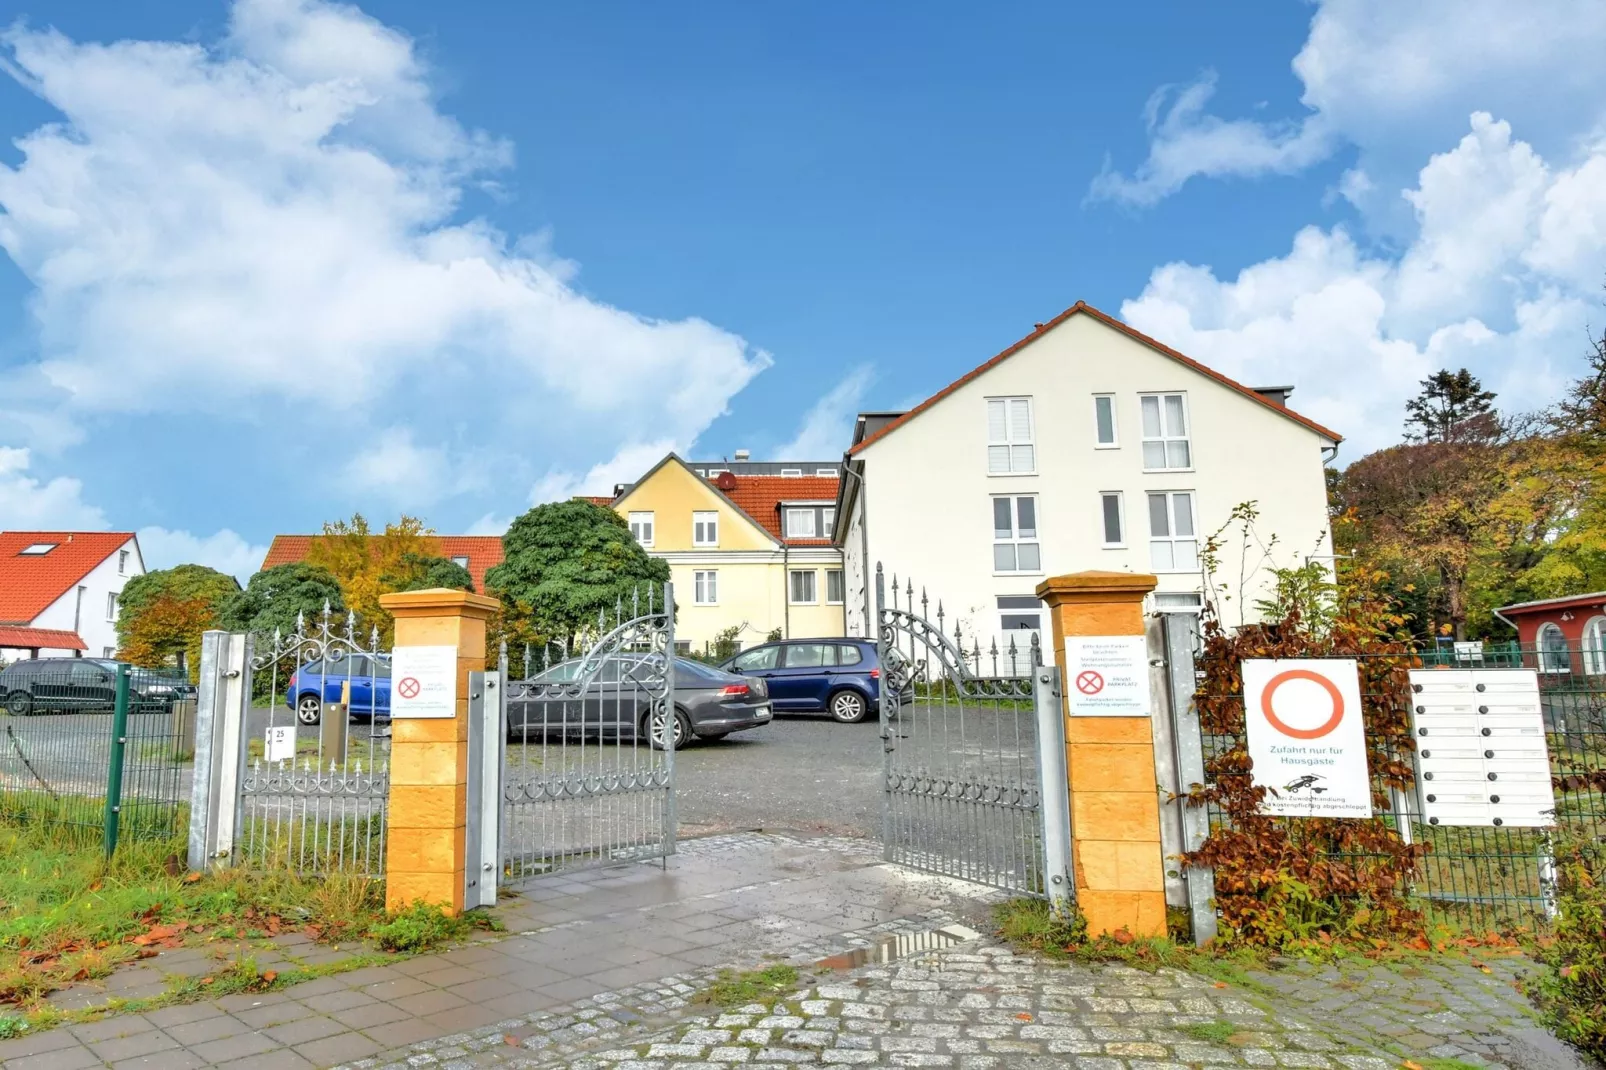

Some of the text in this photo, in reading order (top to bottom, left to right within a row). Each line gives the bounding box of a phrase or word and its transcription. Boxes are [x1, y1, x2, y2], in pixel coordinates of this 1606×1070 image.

[276, 730, 285, 738] 25
[1269, 745, 1344, 755] Zufahrt nur für
[1280, 756, 1336, 767] Hausgäste
